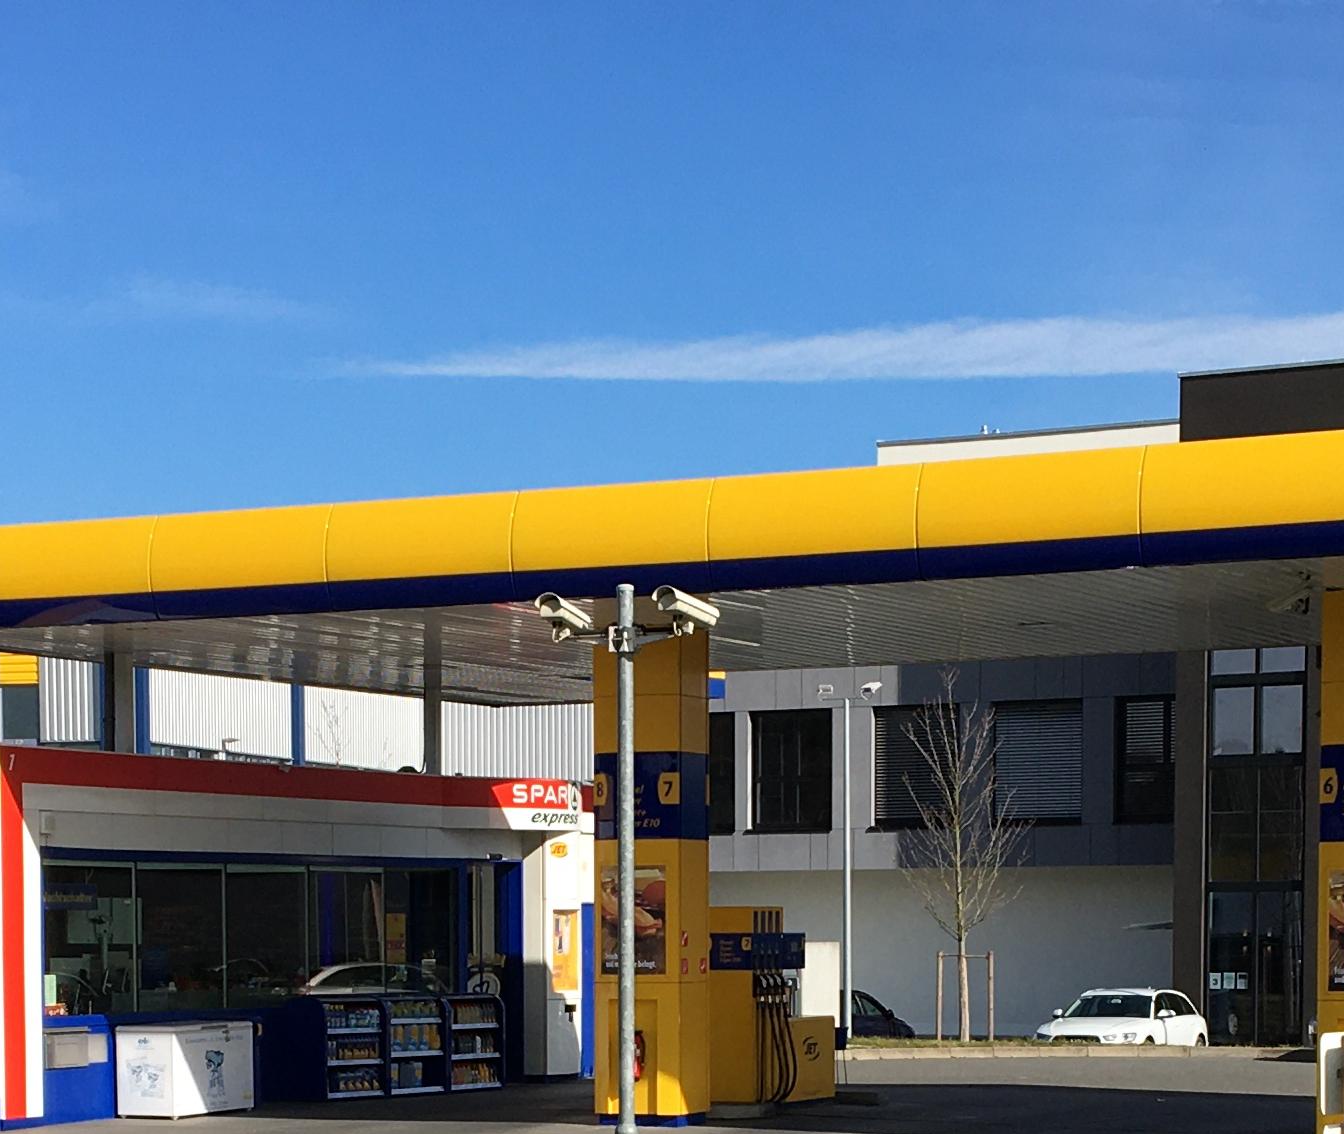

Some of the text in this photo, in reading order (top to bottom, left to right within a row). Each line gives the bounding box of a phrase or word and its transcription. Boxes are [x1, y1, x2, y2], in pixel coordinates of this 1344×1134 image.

[512, 783, 568, 804] SPAR
[596, 781, 604, 797] 8
[662, 781, 673, 797] 7
[1323, 776, 1333, 794] 6
[531, 810, 579, 827] express
